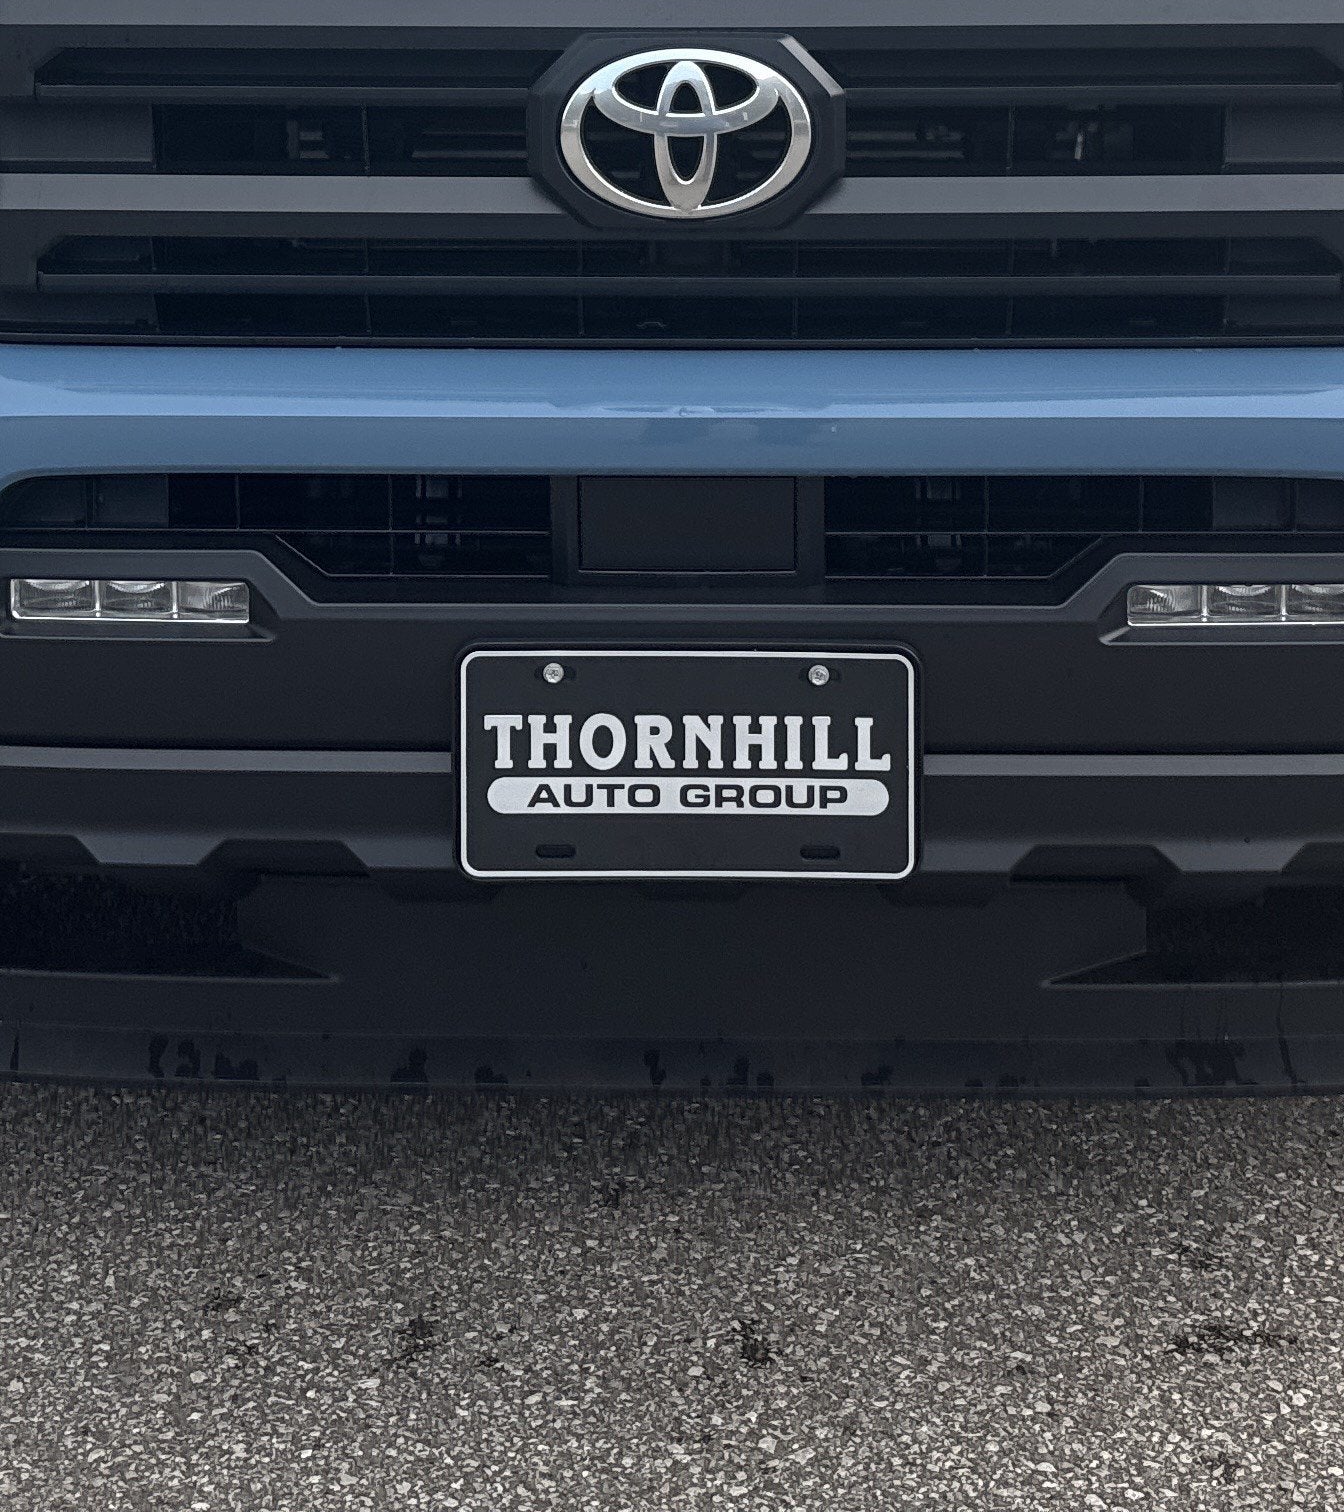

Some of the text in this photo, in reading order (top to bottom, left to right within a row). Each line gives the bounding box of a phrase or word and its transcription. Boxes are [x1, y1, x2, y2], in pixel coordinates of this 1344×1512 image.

[483, 712, 892, 772] THORNHILL
[527, 783, 849, 810] AUTO GROUP
